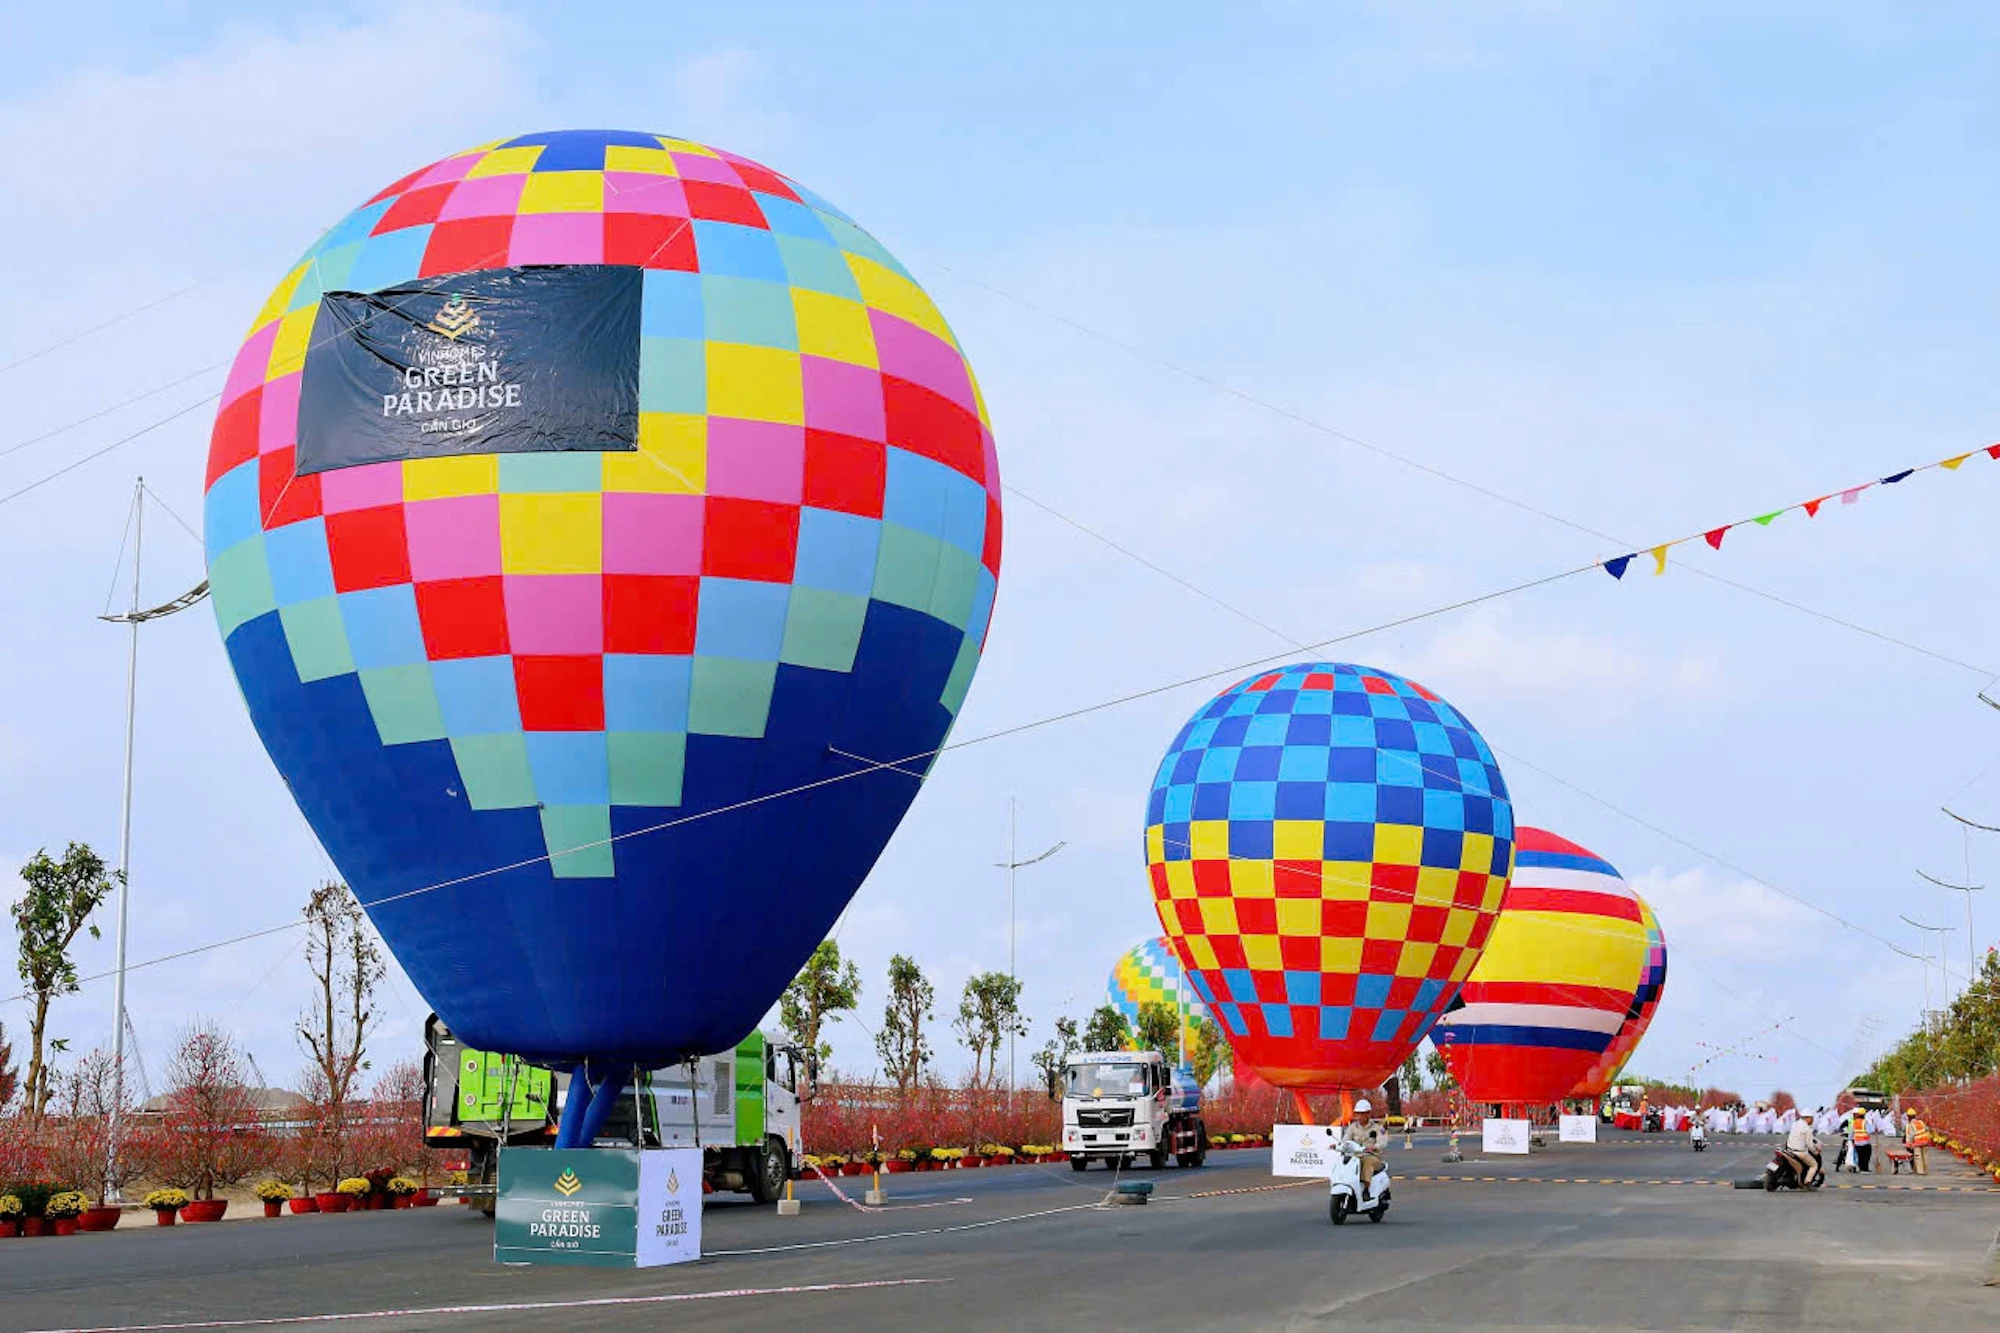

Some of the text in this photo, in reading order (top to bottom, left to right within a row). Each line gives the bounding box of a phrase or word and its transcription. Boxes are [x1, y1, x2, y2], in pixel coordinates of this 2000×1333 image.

[405, 360, 498, 389] GREEN
[383, 383, 523, 417] PARADISE
[541, 1209, 590, 1223] GREEN
[662, 1208, 684, 1222] GREEN
[530, 1222, 601, 1239] PARADISE
